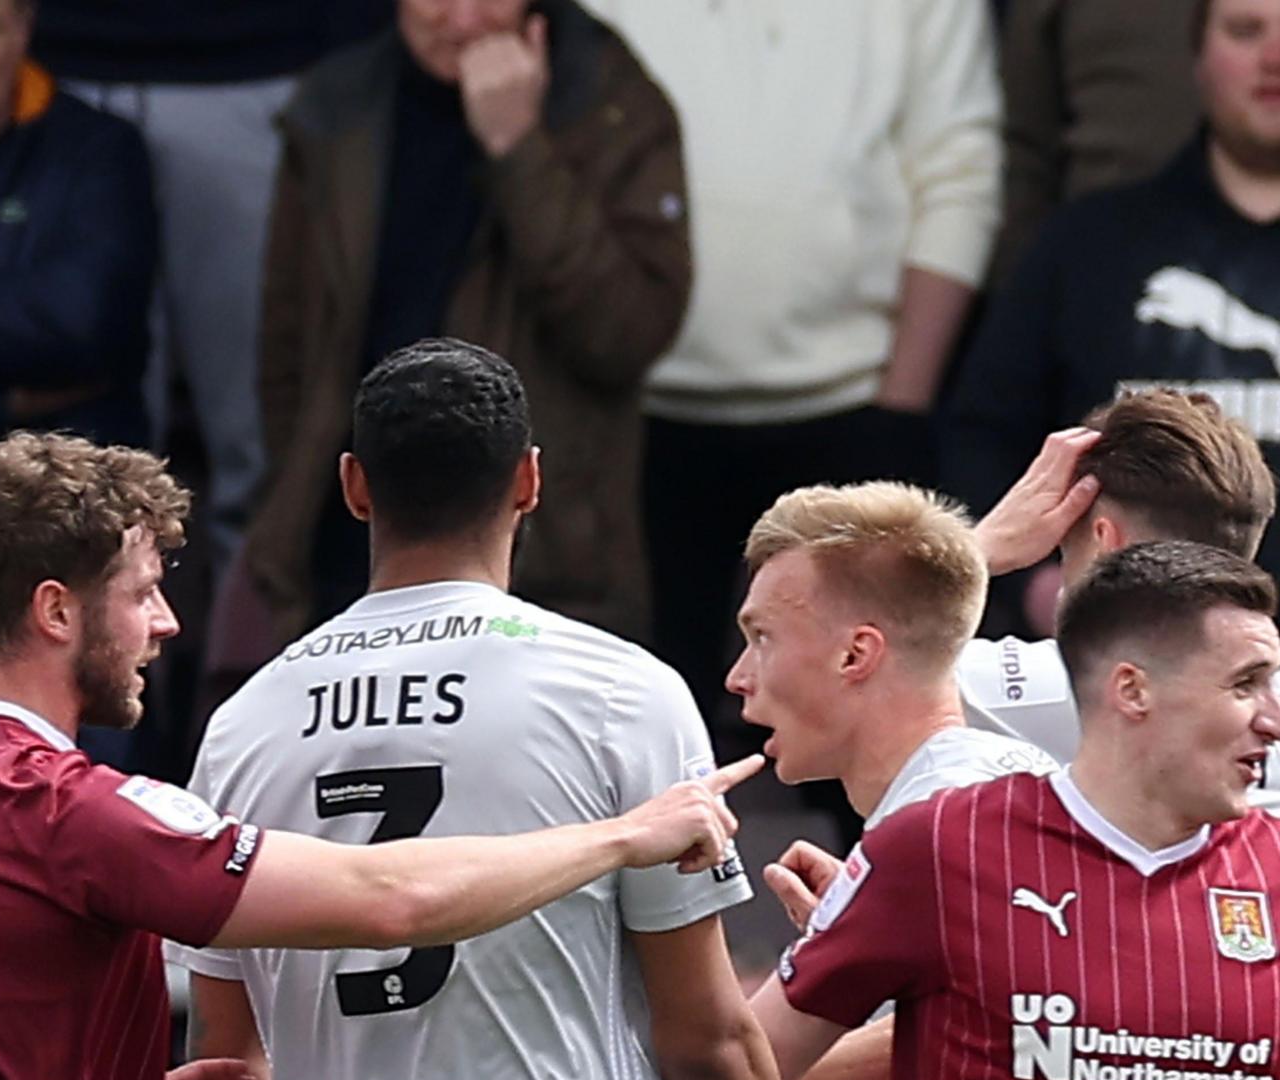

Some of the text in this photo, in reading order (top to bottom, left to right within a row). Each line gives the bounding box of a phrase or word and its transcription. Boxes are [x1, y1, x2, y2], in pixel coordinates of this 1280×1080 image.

[1003, 636, 1028, 701] urple
[301, 673, 467, 738] JULES
[1073, 1026, 1271, 1067] University of
